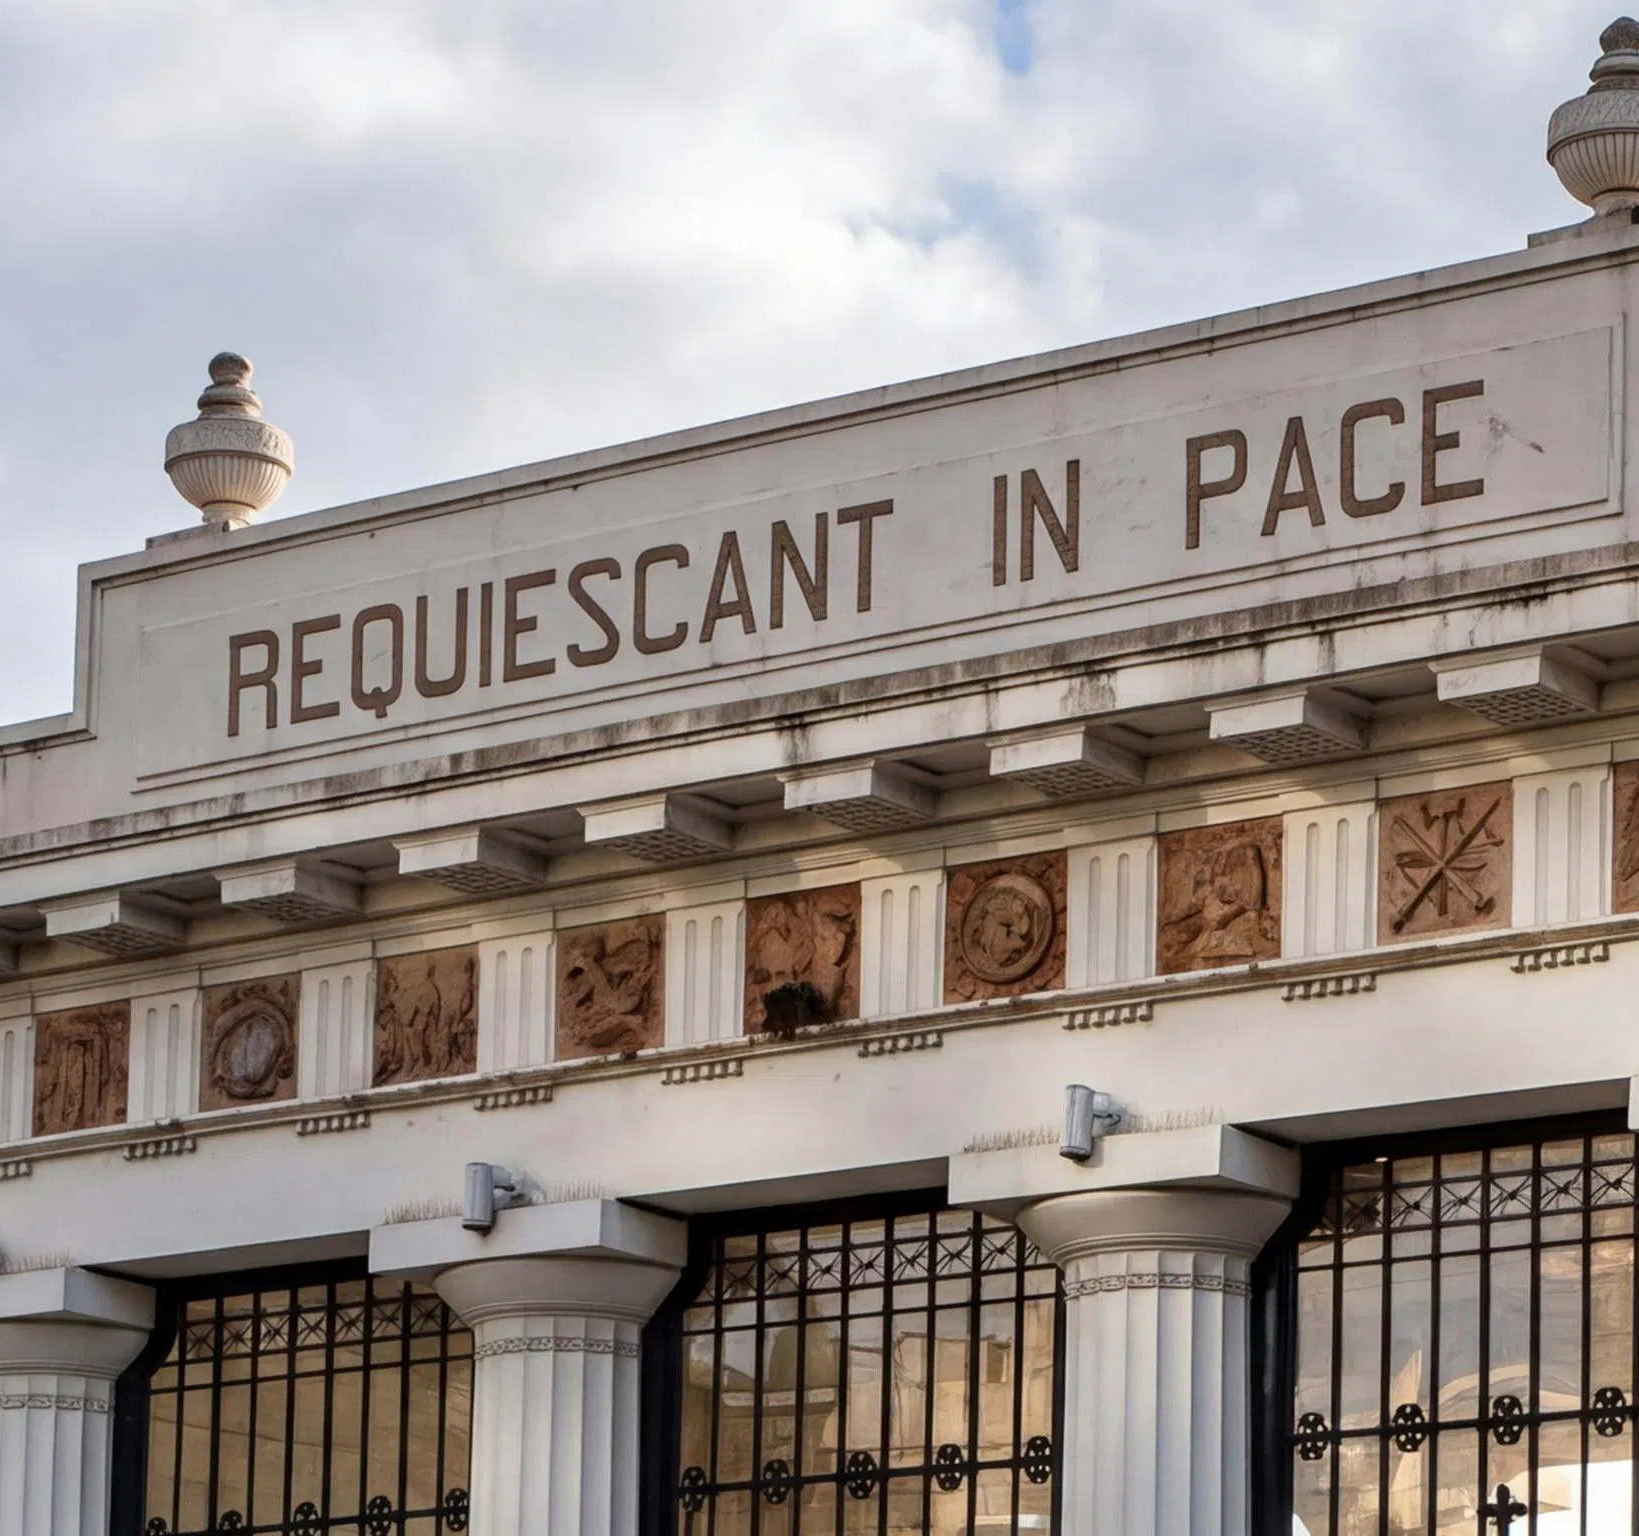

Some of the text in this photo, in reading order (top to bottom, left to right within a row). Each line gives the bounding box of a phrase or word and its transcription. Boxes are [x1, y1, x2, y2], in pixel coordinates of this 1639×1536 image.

[227, 380, 1485, 739] REQUIESCANT IN PACE
